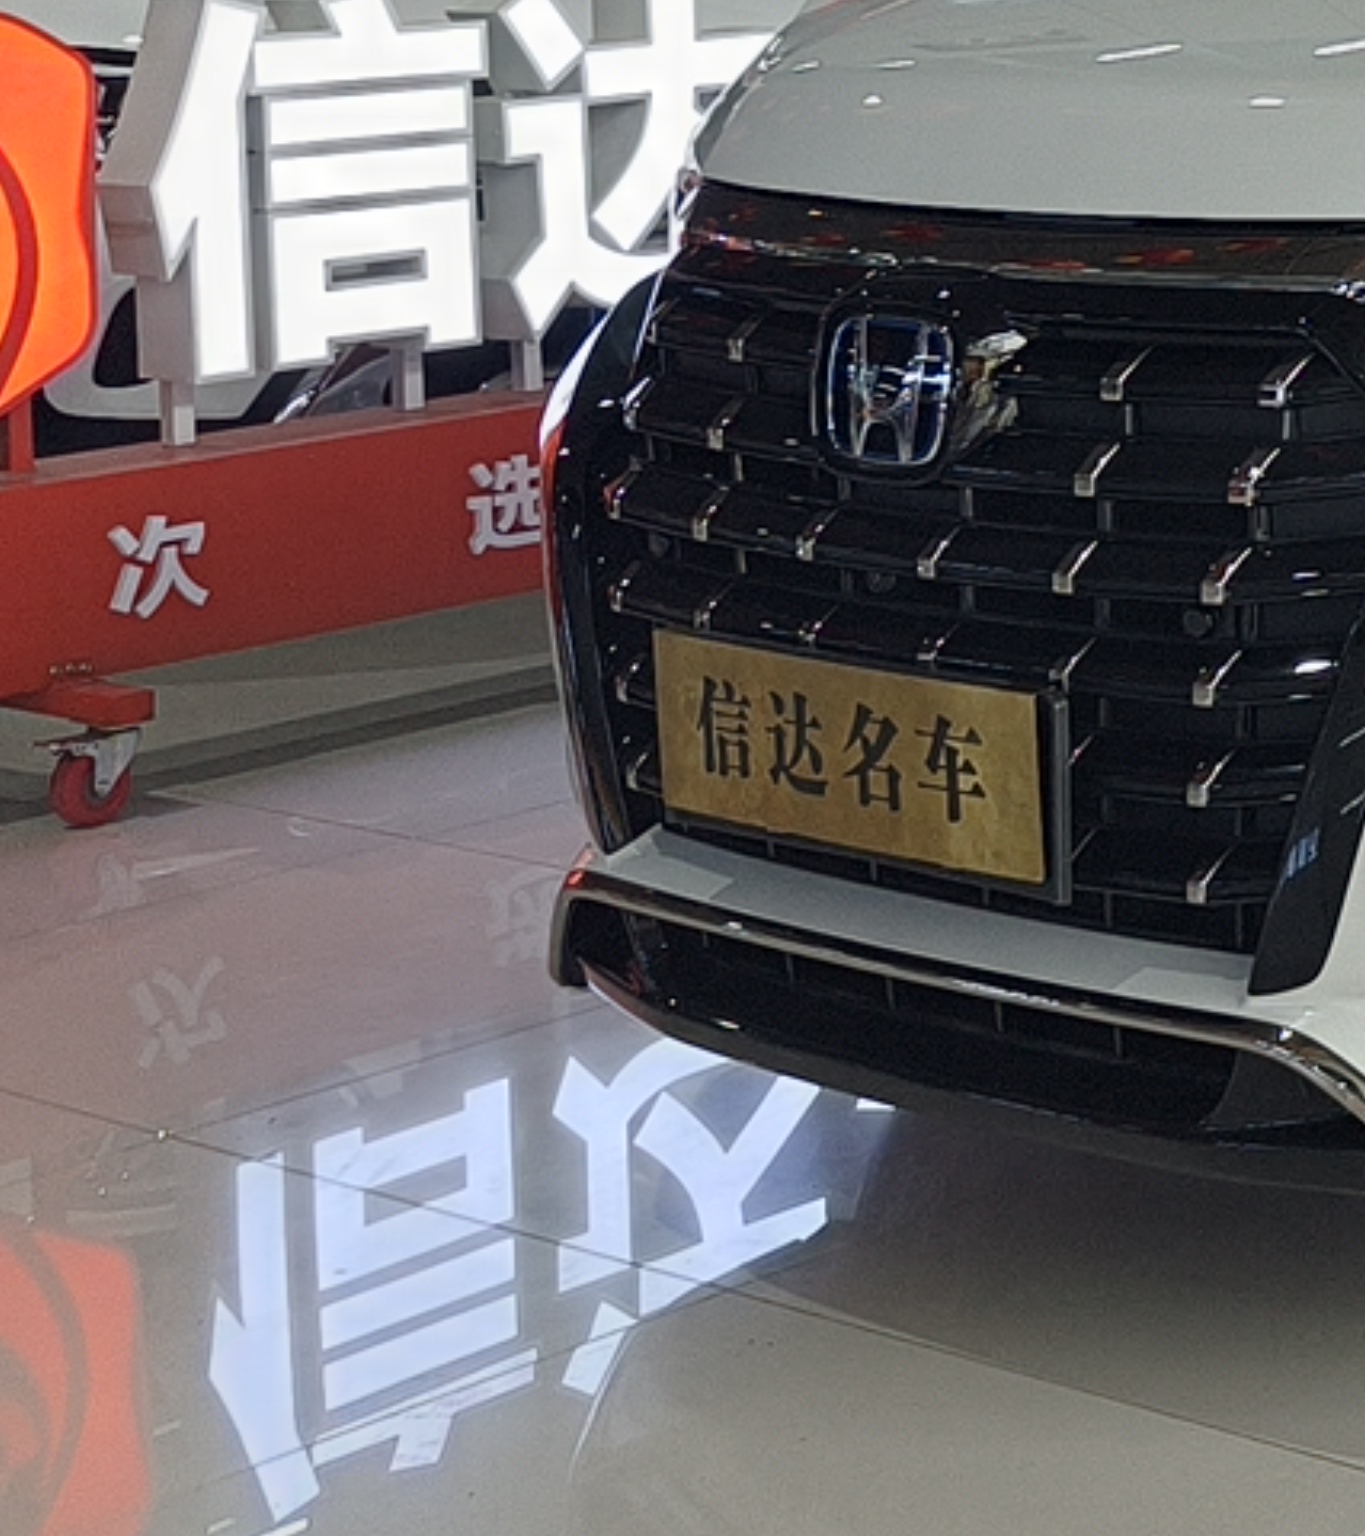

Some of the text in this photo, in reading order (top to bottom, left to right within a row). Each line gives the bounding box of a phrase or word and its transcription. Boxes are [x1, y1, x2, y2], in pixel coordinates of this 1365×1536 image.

[107, 514, 209, 621] 次
[696, 675, 987, 824] 信达名车
